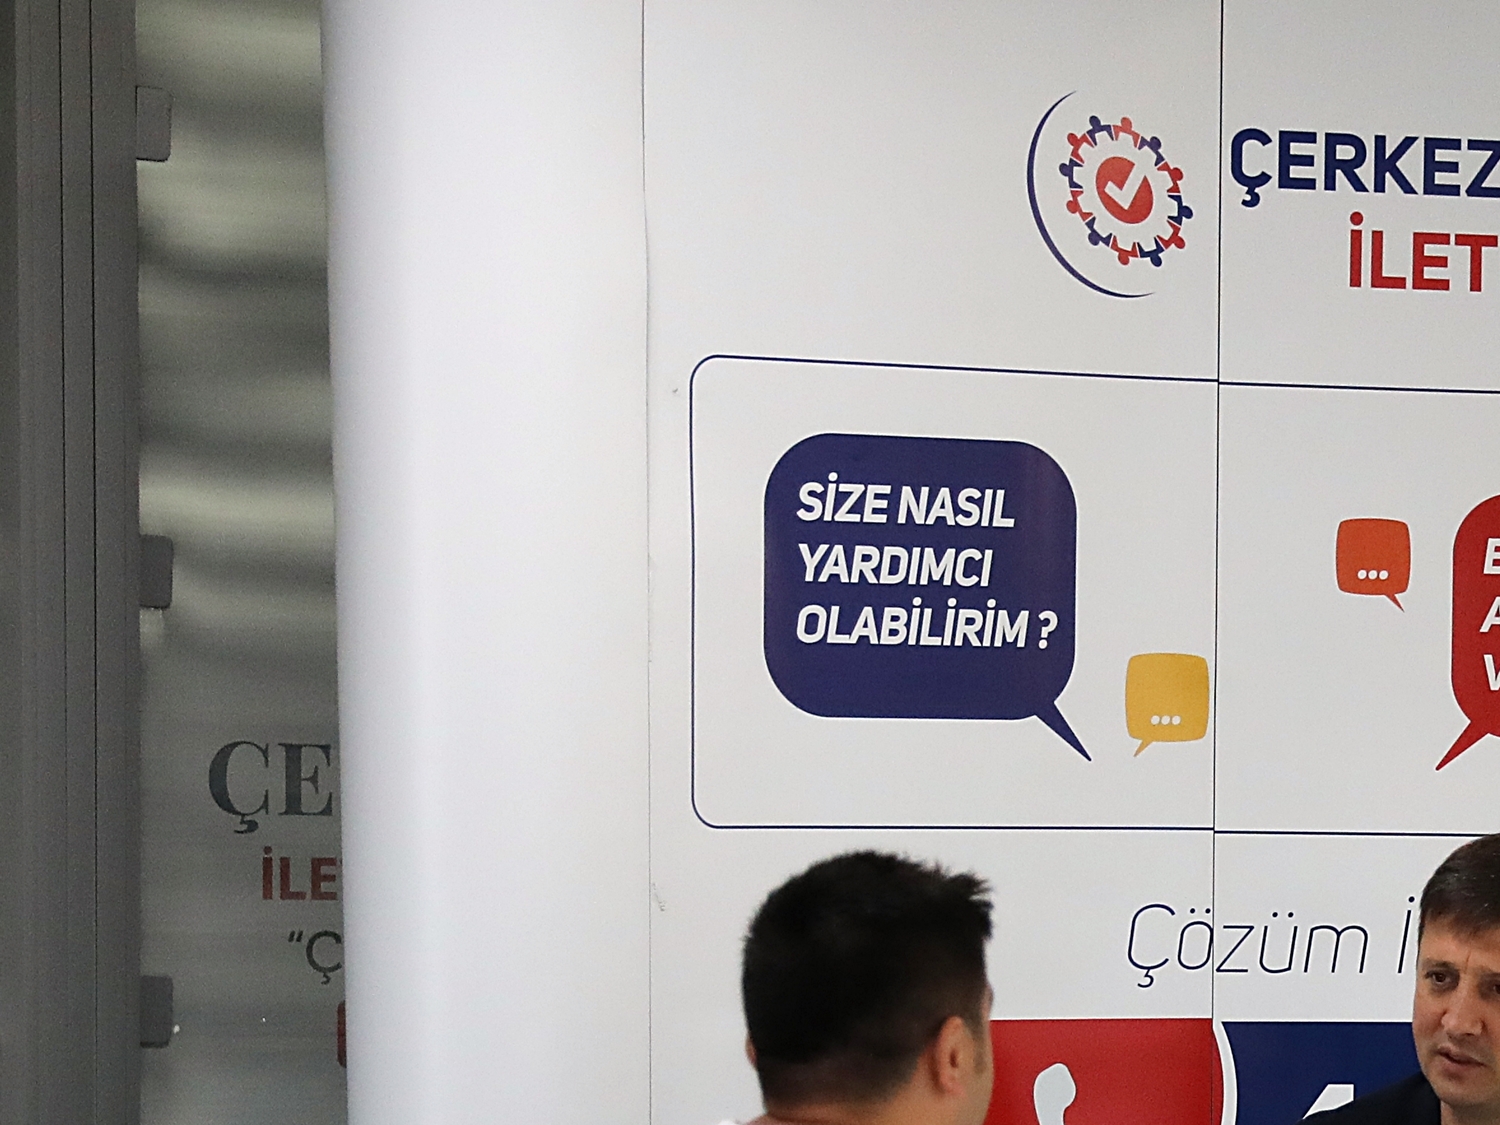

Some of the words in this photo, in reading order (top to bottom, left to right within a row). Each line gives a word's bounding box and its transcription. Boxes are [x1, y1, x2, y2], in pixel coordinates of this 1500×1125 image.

[796, 471, 891, 524] SİZE
[897, 486, 1016, 528] NASIL
[797, 543, 993, 587] YARDIMCI
[796, 596, 1030, 648] OLABİLİRİM
[1036, 610, 1059, 650] ?
[1127, 902, 1369, 988] Çözüm
